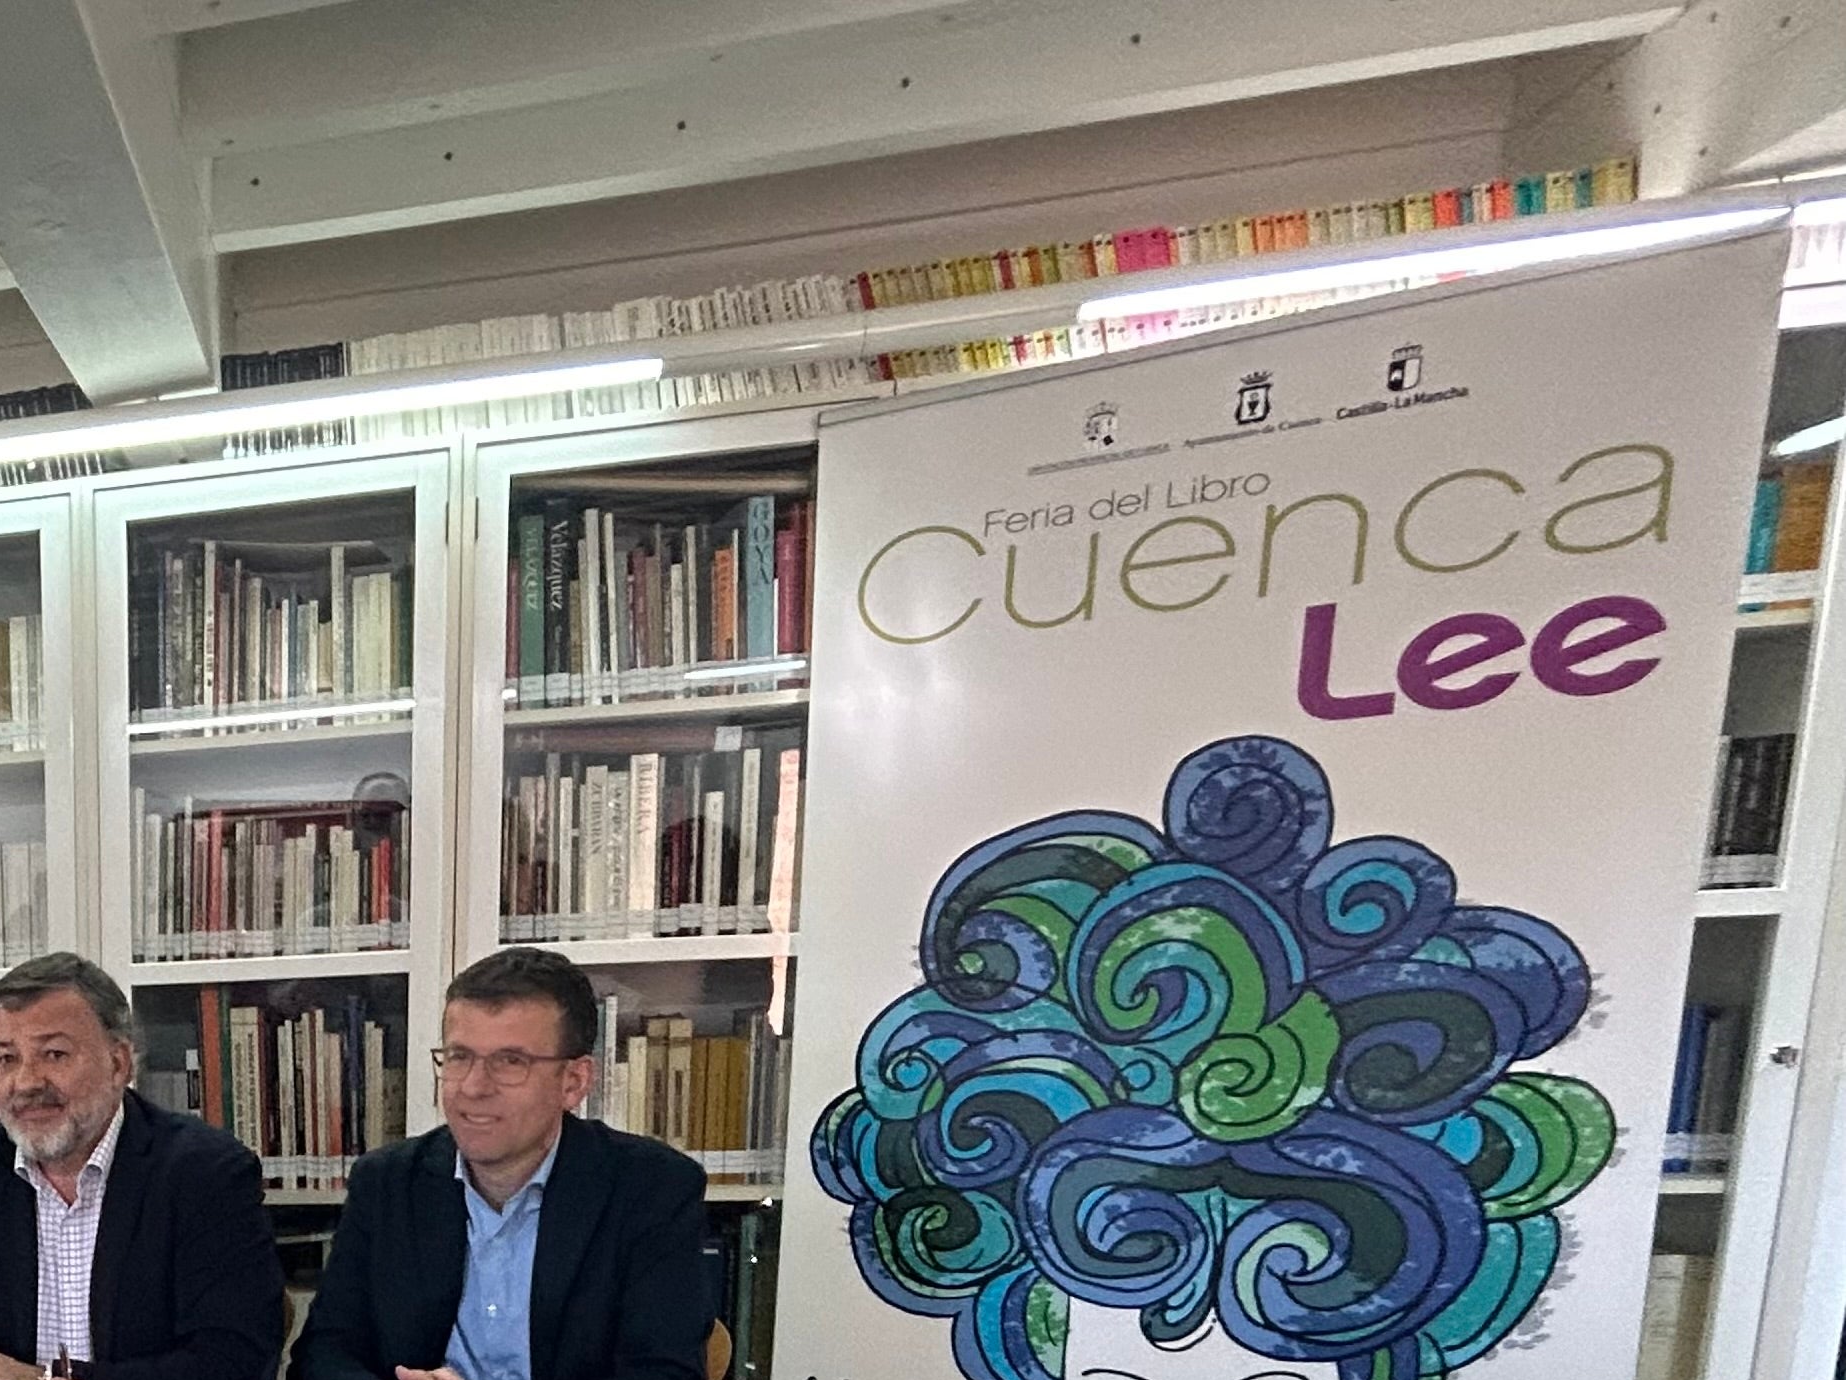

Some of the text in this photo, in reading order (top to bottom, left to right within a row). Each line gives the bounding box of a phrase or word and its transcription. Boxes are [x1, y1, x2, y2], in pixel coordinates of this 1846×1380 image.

[753, 500, 771, 586] GOYA
[856, 444, 1675, 645] Cuenca
[983, 471, 1272, 538] Feria del Libro
[1297, 594, 1668, 721] Lee
[637, 763, 652, 834] RIBERA
